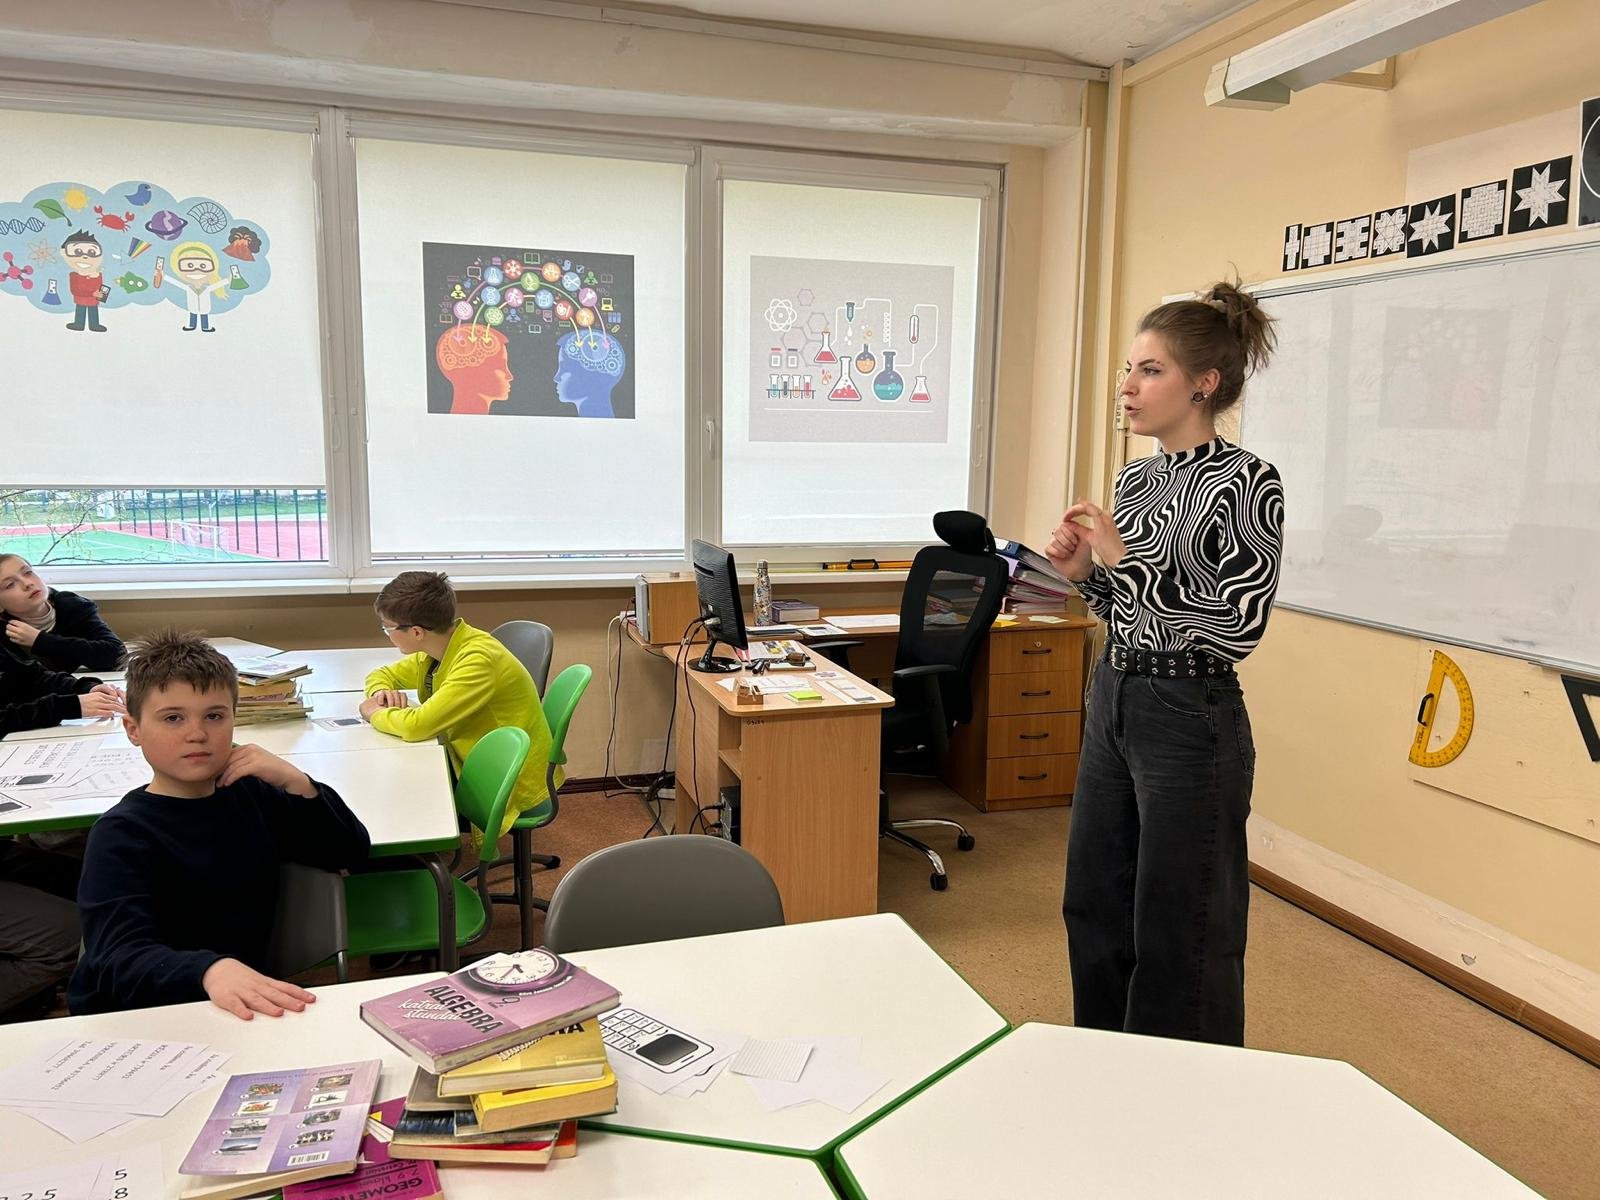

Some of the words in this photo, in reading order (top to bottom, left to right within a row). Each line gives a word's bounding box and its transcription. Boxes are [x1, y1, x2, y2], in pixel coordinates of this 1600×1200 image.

[424, 985, 504, 1033] ALGEBRA
[114, 1168, 128, 1181] 5
[40, 1188, 57, 1200] 5
[114, 1186, 129, 1199] 8
